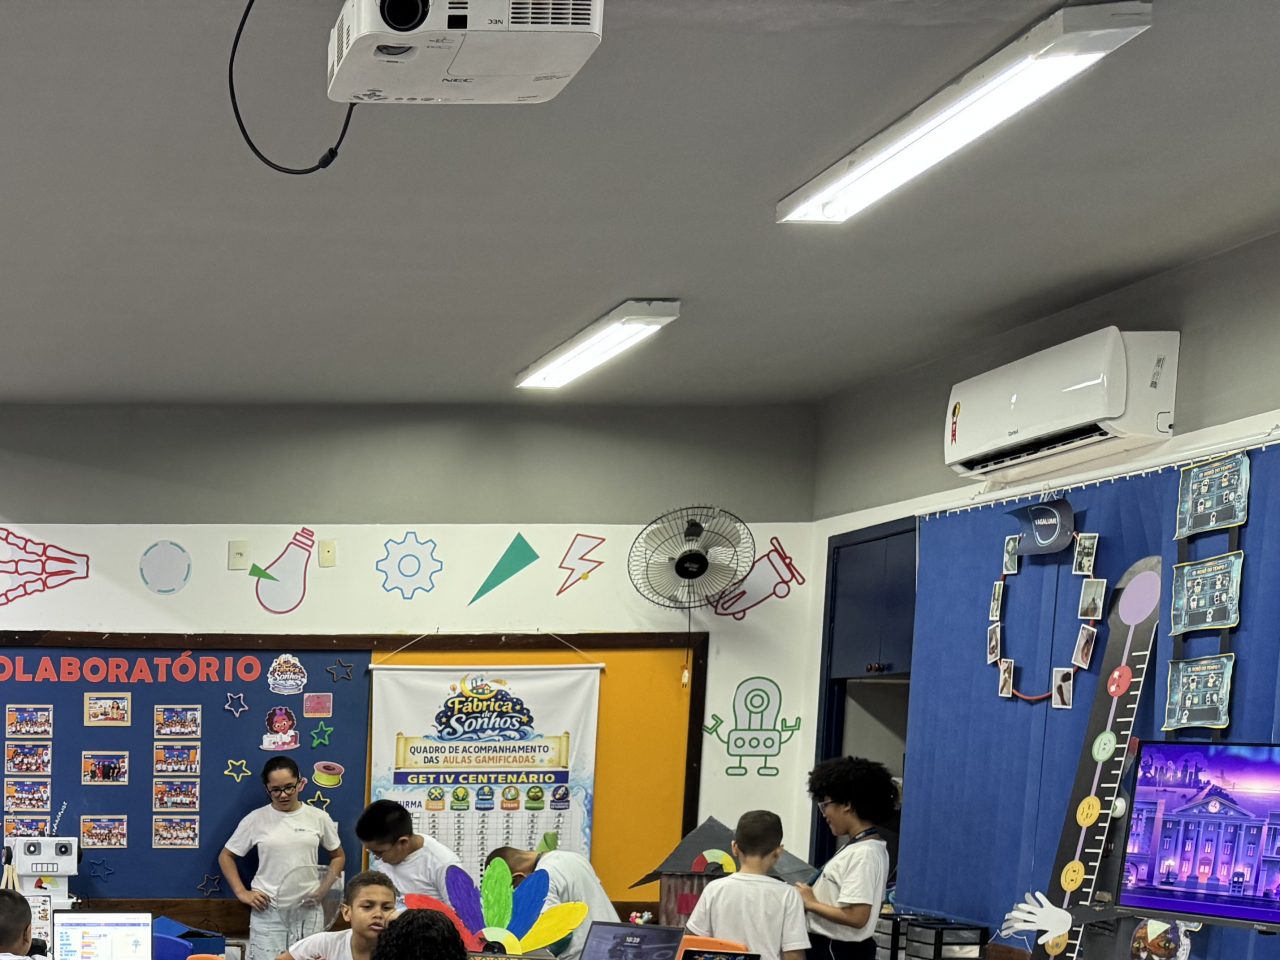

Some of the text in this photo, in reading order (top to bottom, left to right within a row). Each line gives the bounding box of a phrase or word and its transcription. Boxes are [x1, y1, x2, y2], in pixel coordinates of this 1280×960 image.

[447, 697, 514, 715] Fábrica
[442, 713, 521, 738] Sonhos
[409, 745, 550, 755] QUADRO DE ACOMPANHAMENTO
[423, 755, 536, 764] DAS AULAS GAMIFICADAS
[407, 772, 556, 784] GET IV CENTENÁRIO
[398, 800, 423, 809] URMA
